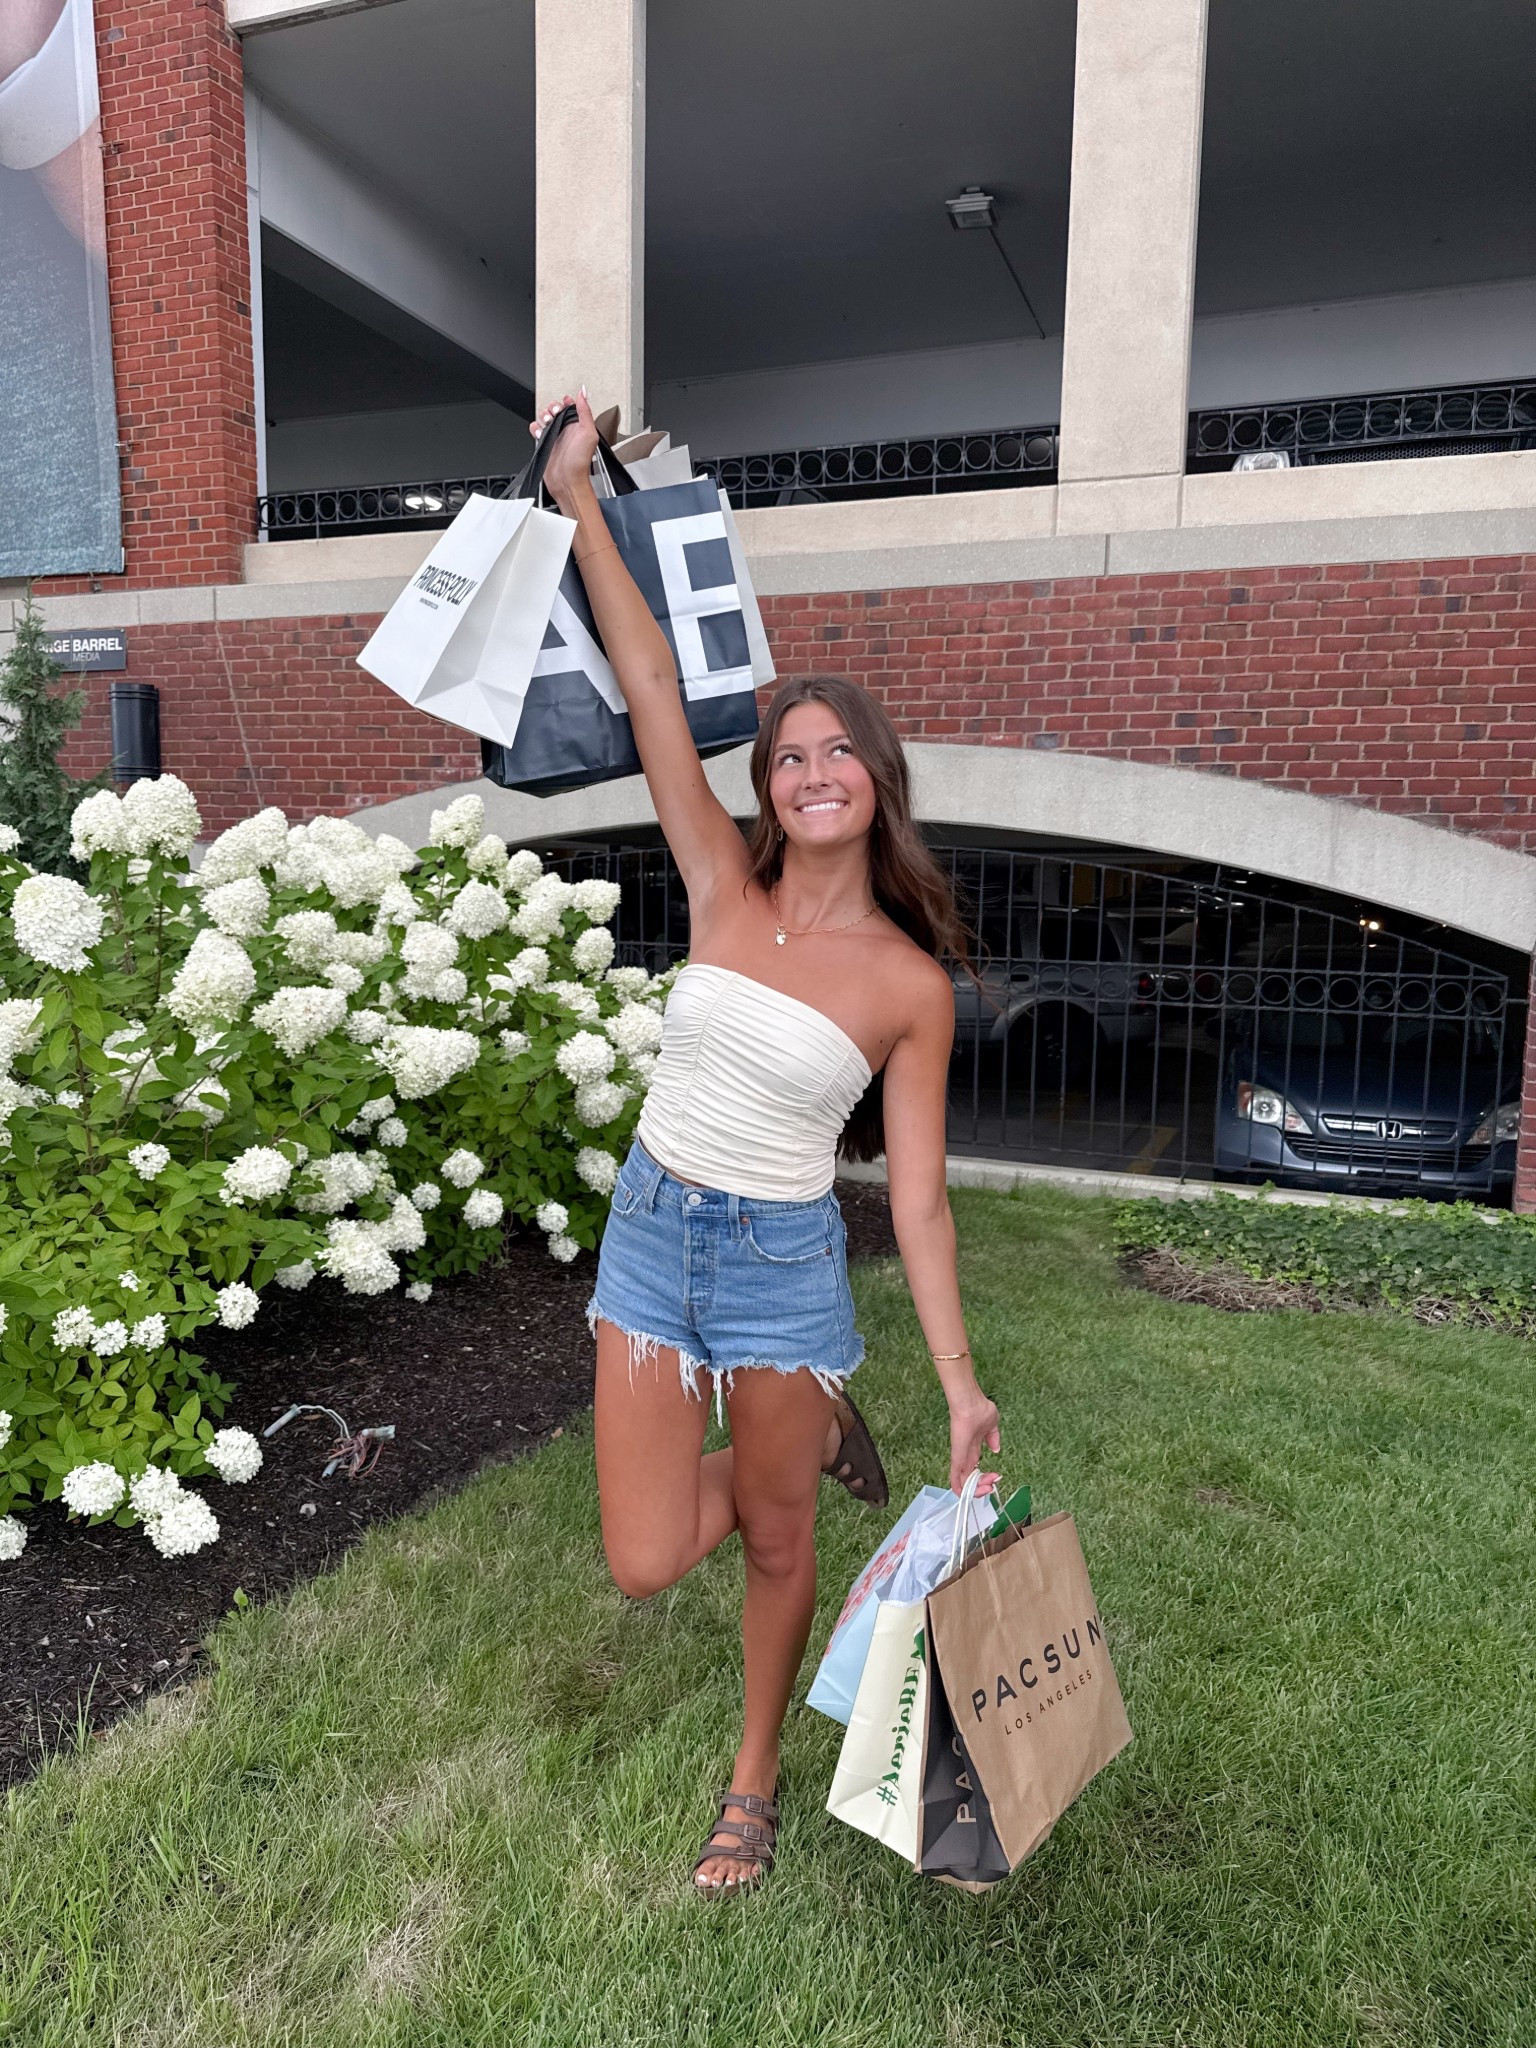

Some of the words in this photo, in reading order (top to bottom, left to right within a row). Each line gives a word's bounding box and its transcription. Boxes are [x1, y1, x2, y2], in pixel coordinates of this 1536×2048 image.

[73, 637, 123, 653] BARREL
[73, 652, 100, 662] MEDIA
[972, 1615, 1101, 1723] PACSUN
[1004, 1712, 1032, 1735] LOS
[1039, 1669, 1092, 1714] ANGELES
